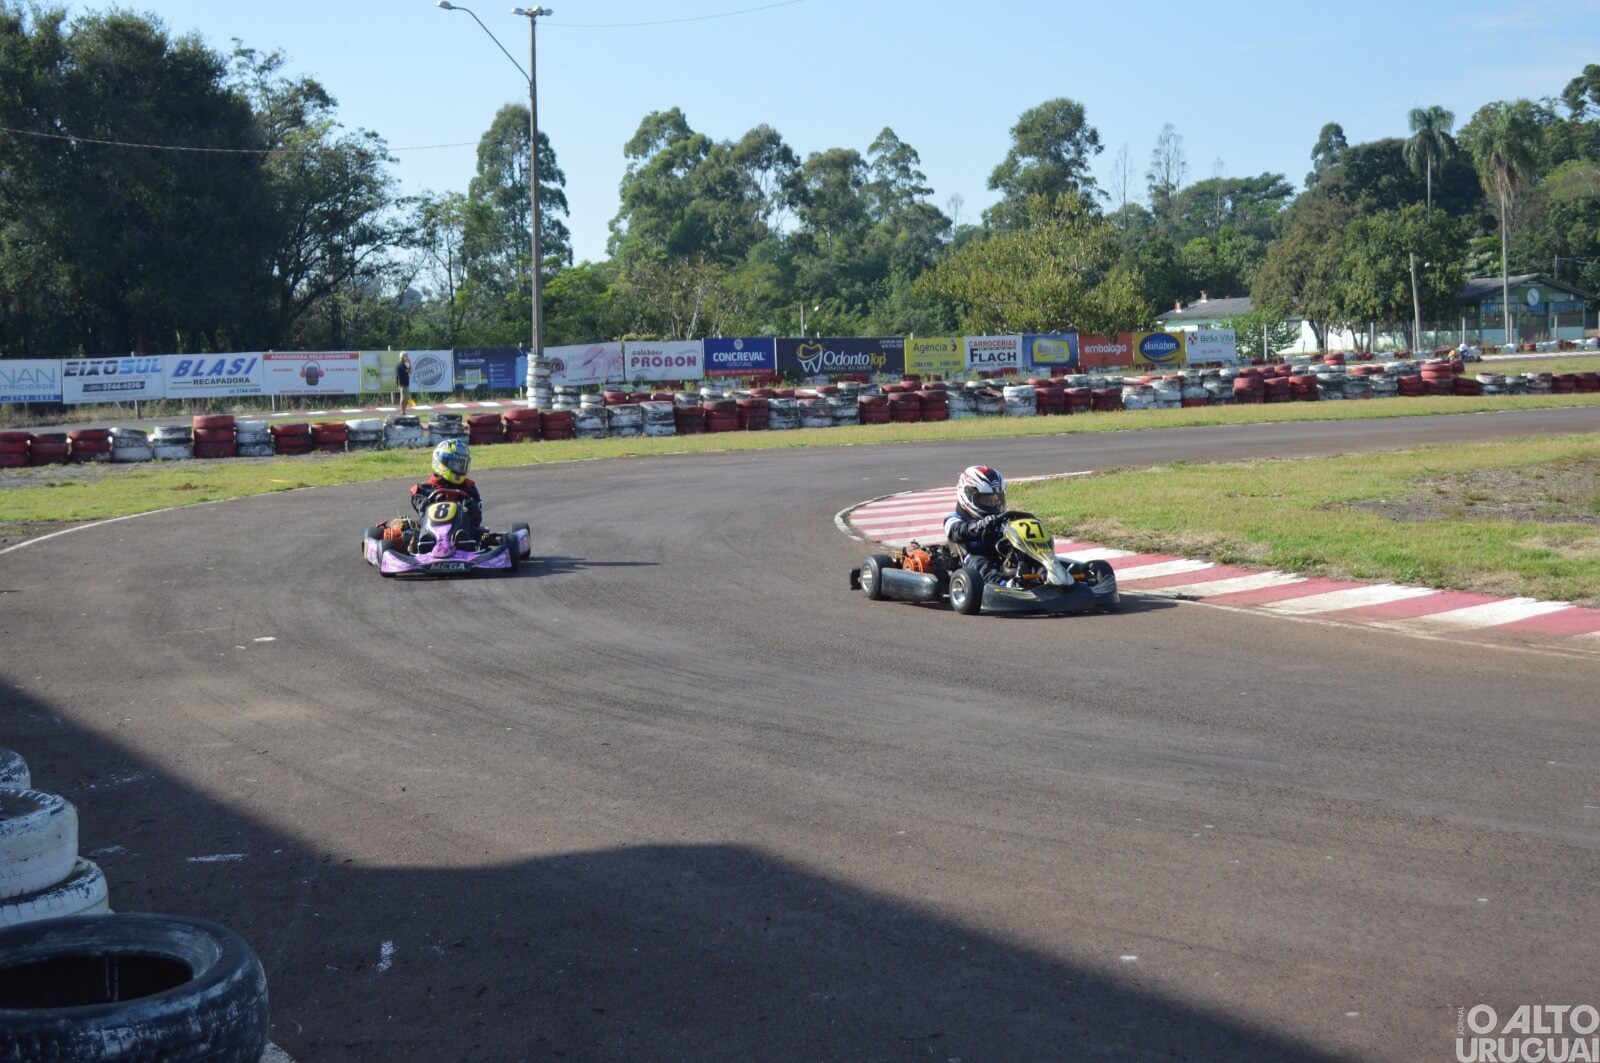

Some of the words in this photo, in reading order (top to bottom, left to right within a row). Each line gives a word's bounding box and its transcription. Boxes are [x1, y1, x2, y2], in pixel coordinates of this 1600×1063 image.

[968, 339, 1017, 348] CARROCERIAS
[713, 351, 765, 362] CONCREVAL
[970, 348, 1017, 362] FLACH
[630, 356, 697, 367] PROBON
[193, 377, 250, 385] RECAPADORA
[434, 503, 451, 519] 8
[1019, 521, 1044, 539] 27
[430, 562, 465, 570] MEGA
